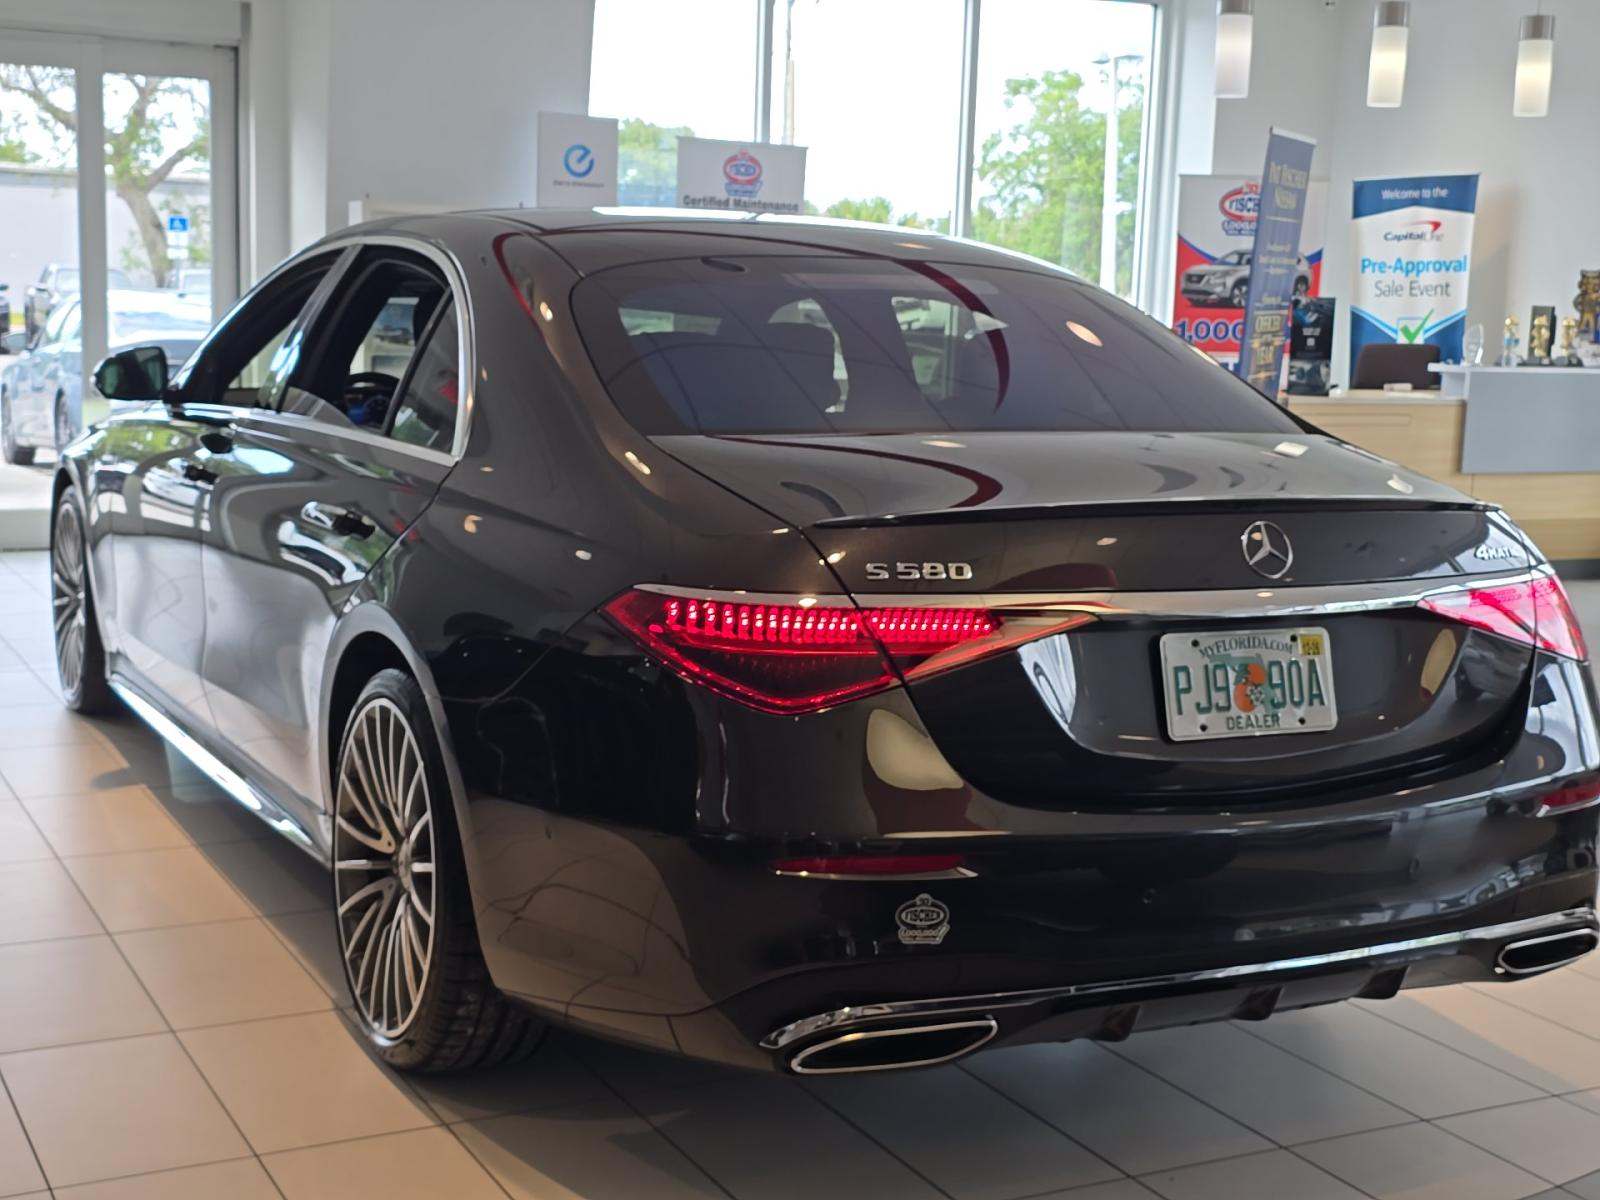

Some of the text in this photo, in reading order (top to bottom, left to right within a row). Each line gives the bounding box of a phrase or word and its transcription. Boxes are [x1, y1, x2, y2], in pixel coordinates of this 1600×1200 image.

[1381, 185, 1449, 200] Welcome to the
[682, 194, 799, 213] Certified Maintenance
[1360, 255, 1467, 277] Pre-Approval
[1374, 279, 1451, 298] Sale Event
[865, 562, 973, 580] S 580
[1199, 635, 1294, 658] MYFLORIDA.COM
[1226, 713, 1281, 731] DEALER
